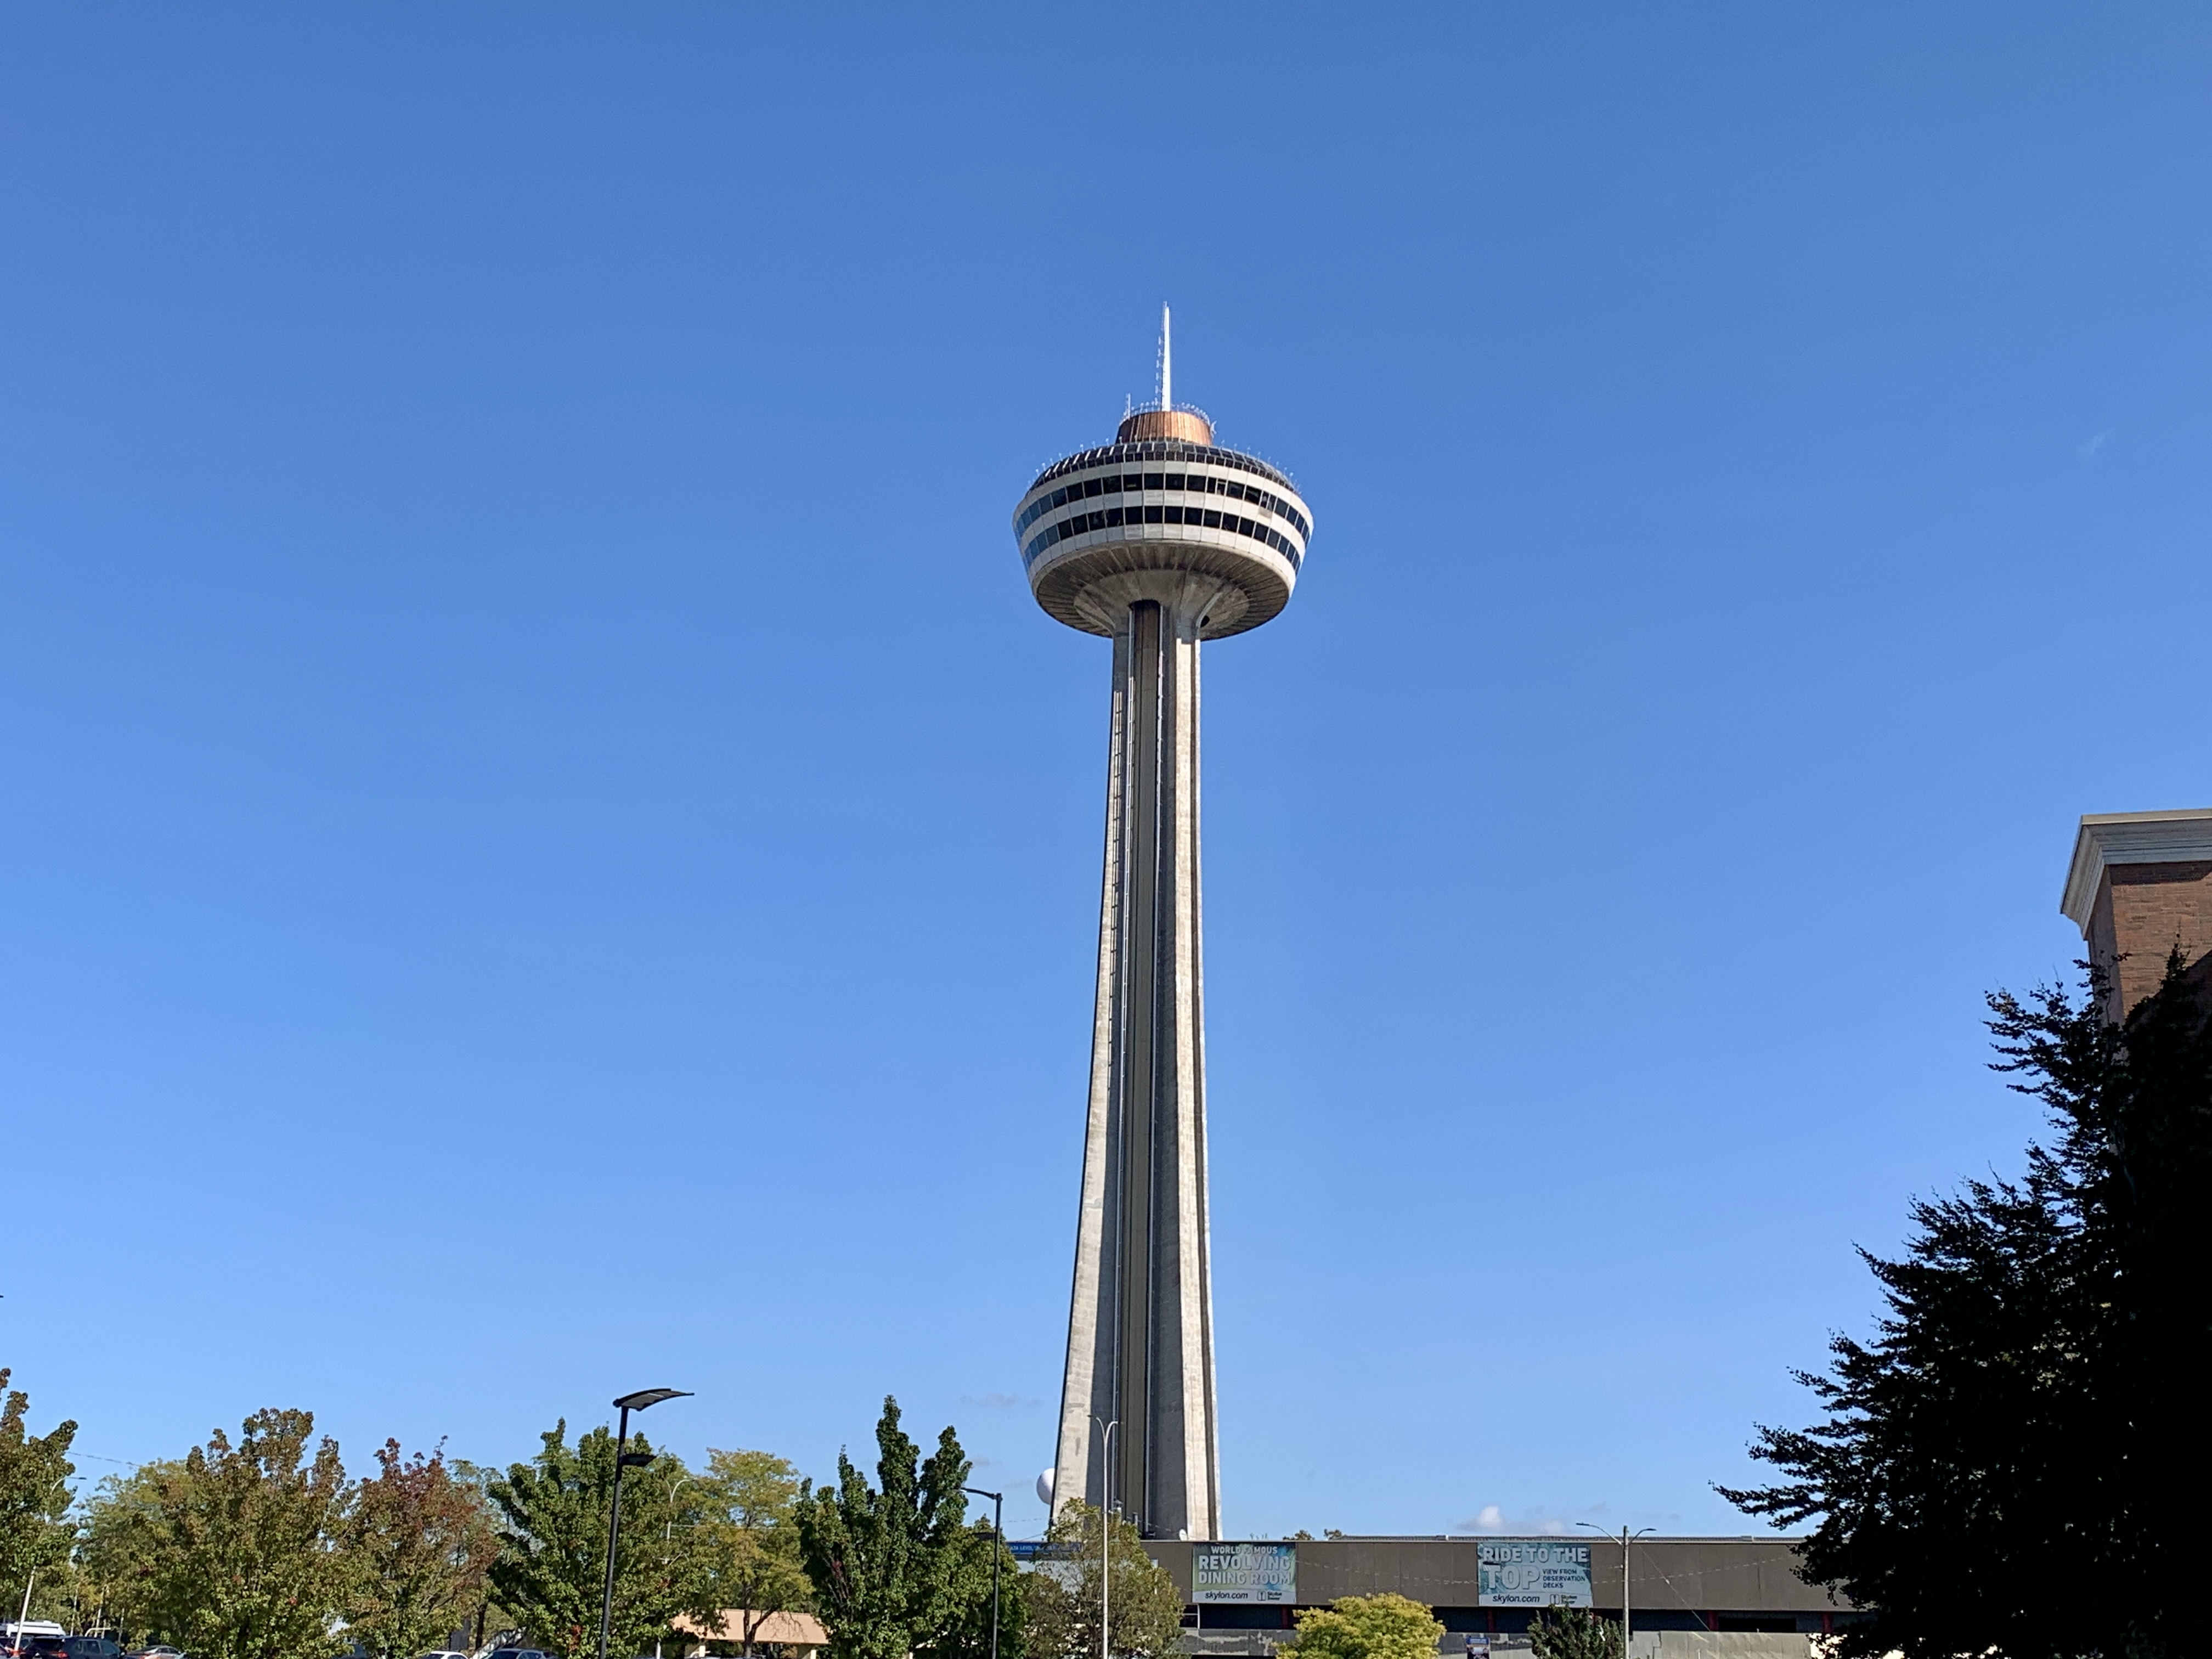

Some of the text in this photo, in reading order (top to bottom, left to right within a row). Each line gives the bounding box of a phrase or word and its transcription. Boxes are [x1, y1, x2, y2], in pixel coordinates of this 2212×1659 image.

[1211, 1546, 1278, 1554] WORLD FAMOUS
[1483, 1547, 1589, 1563] RIDE TO THE
[1199, 1555, 1291, 1571] REVOLVING
[1198, 1571, 1291, 1585] DINING ROOM
[1483, 1564, 1541, 1590] TOP
[1205, 1590, 1248, 1600] skylon.com
[1492, 1594, 1540, 1604] skylon.com
